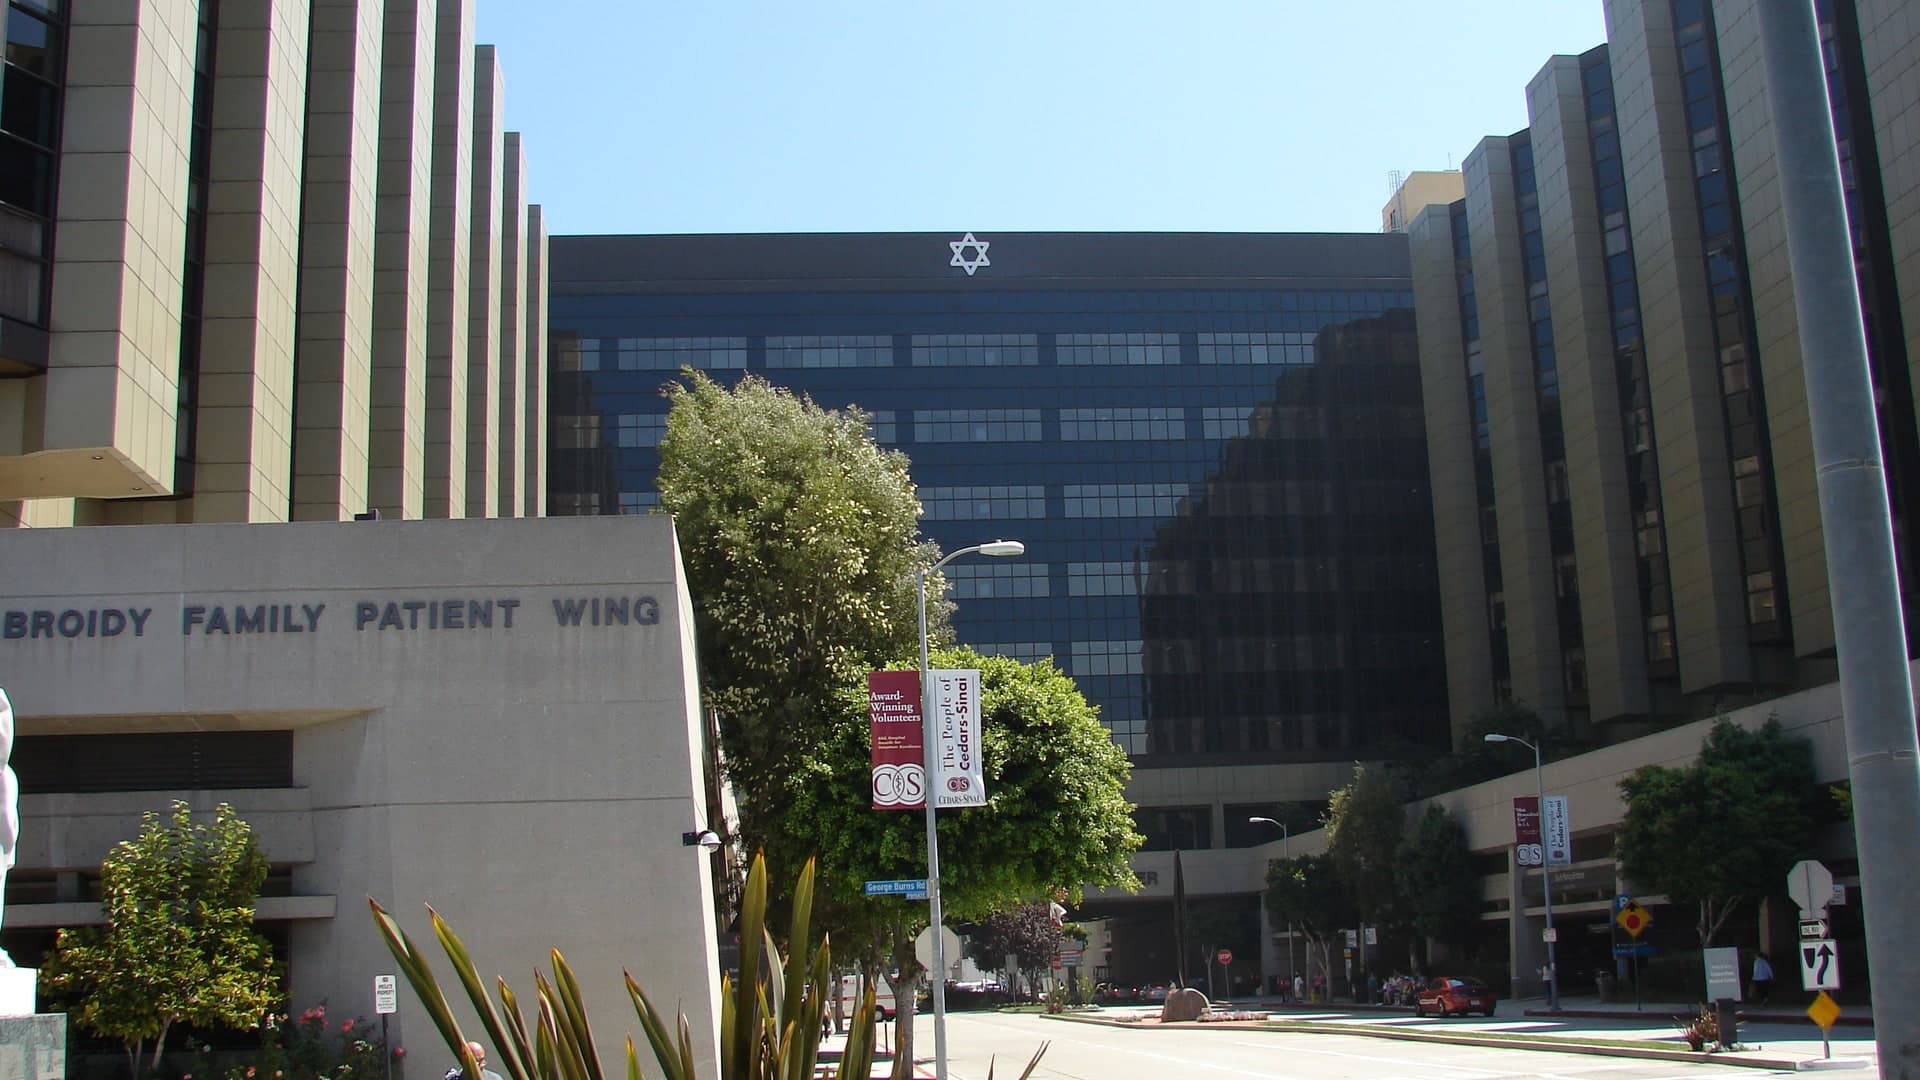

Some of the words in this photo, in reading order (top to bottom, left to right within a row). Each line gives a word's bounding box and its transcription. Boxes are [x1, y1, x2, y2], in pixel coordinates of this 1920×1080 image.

[3, 608, 152, 639] BROIDY
[183, 604, 325, 635] FAMILY
[356, 599, 520, 631] PATIENT
[553, 596, 660, 626] WING
[939, 676, 951, 691] of
[870, 690, 904, 701] Award-
[870, 702, 914, 713] Winning
[871, 713, 921, 723] Volunteers
[940, 697, 955, 739] People
[955, 678, 970, 771] Cedars-Sinai
[943, 745, 955, 771] The
[867, 883, 893, 893] George
[894, 882, 915, 891] Burns
